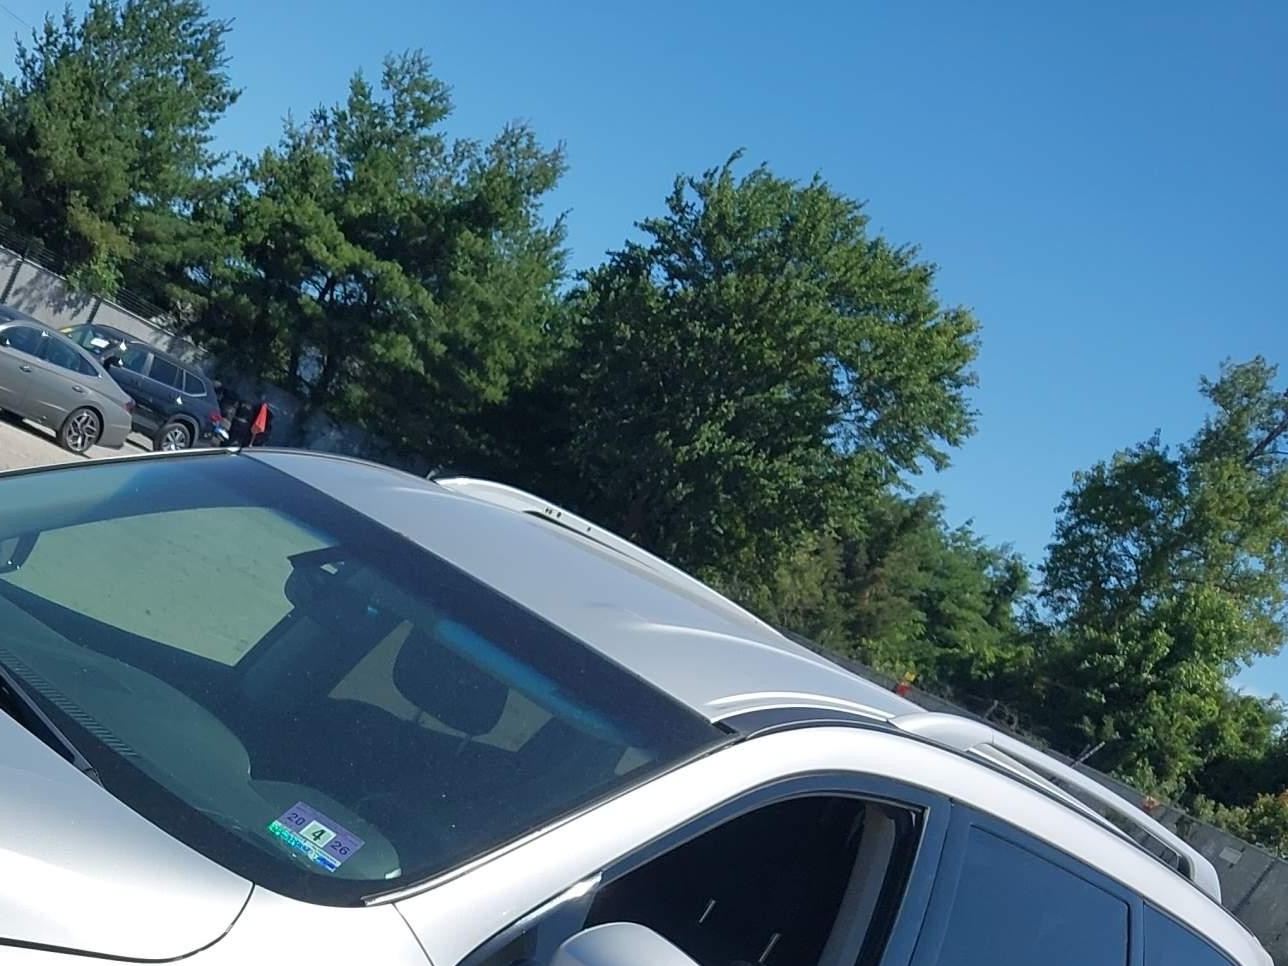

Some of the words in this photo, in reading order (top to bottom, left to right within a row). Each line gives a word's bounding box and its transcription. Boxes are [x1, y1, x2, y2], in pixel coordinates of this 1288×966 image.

[286, 812, 306, 827] 20
[311, 828, 327, 841] 4
[330, 840, 351, 856] 26
